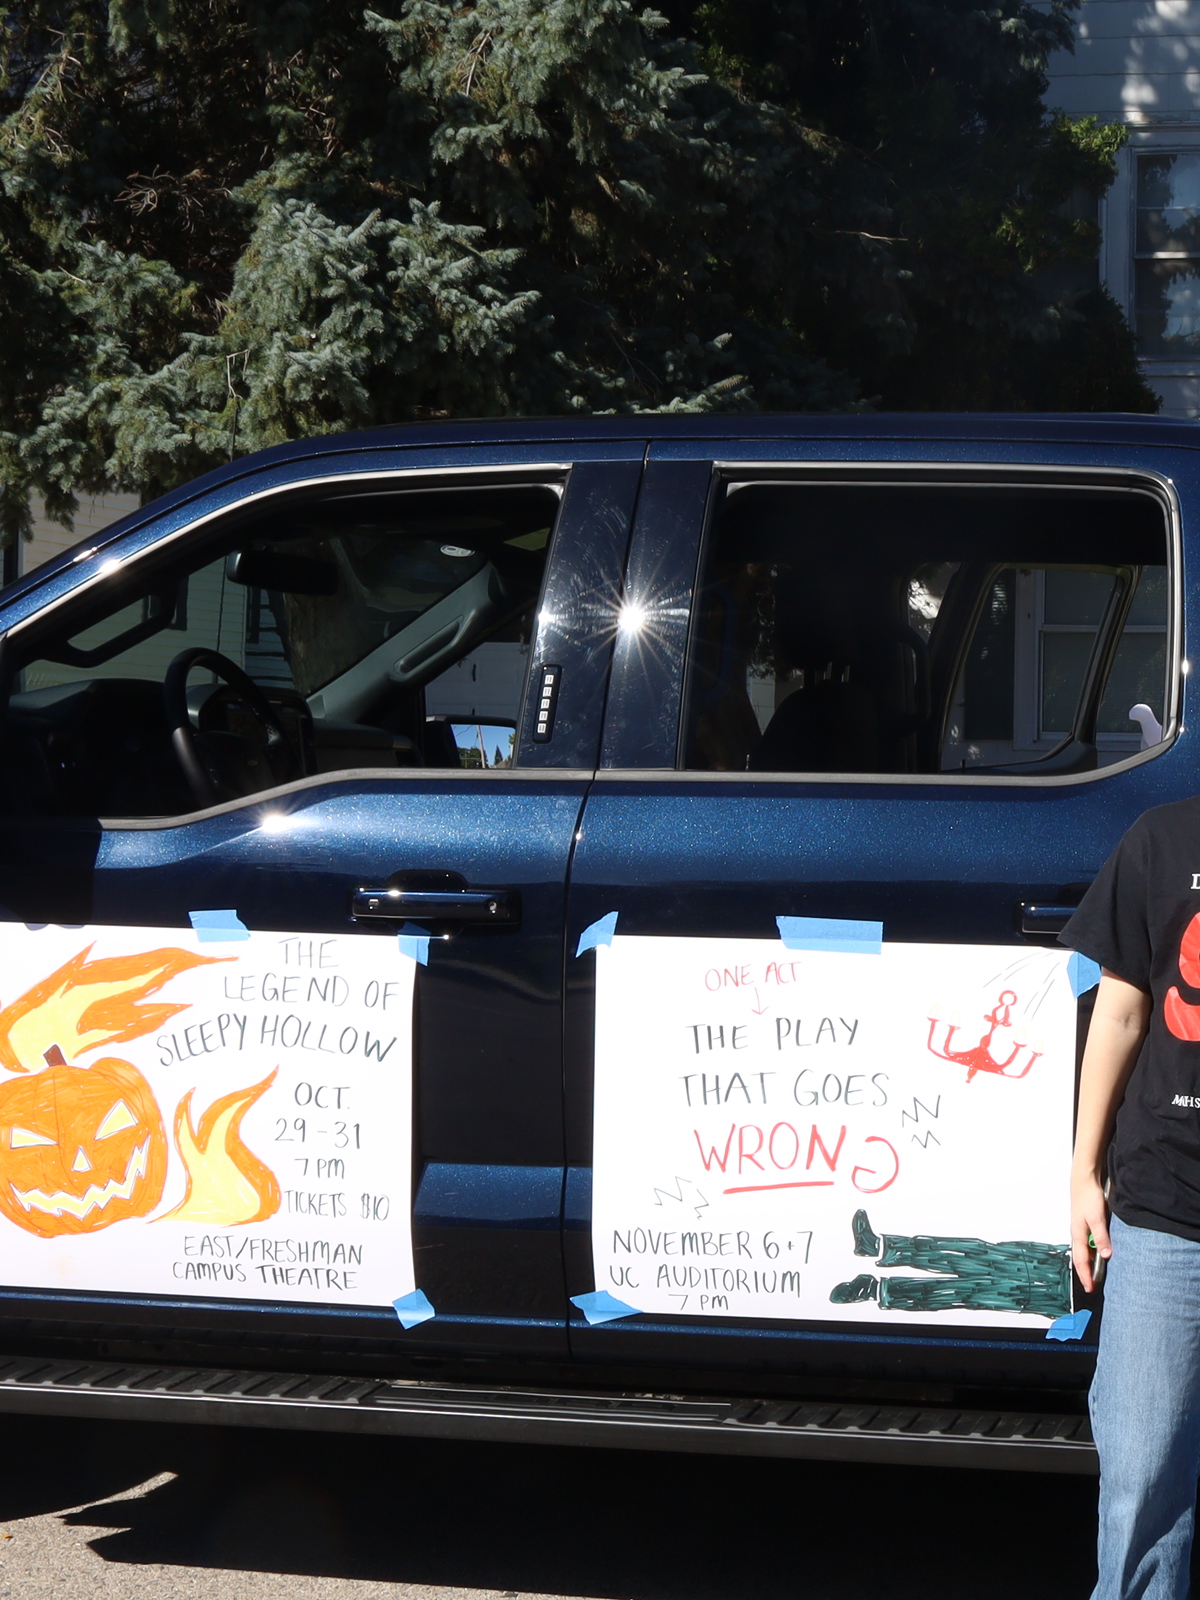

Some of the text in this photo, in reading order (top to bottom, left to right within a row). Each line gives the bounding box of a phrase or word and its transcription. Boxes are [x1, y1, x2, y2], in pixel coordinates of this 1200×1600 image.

[278, 936, 339, 969] THE
[223, 972, 400, 1010] LEGEND OF
[704, 961, 802, 991] ONE ACT
[156, 1013, 398, 1067] SLEEPY HOLLOW
[687, 1017, 859, 1054] THE PLAY
[294, 1082, 351, 1110] OCT.
[678, 1069, 890, 1107] THAT GOES
[693, 1122, 899, 1194] WRONG
[284, 1190, 390, 1221] TICKETS $10
[184, 1235, 363, 1265] EAST/FRESHMAN
[613, 1227, 752, 1259] NOVEMBER
[172, 1262, 358, 1291] CAMPUS THEATRE
[609, 1264, 800, 1298] UC AUDITORIUM
